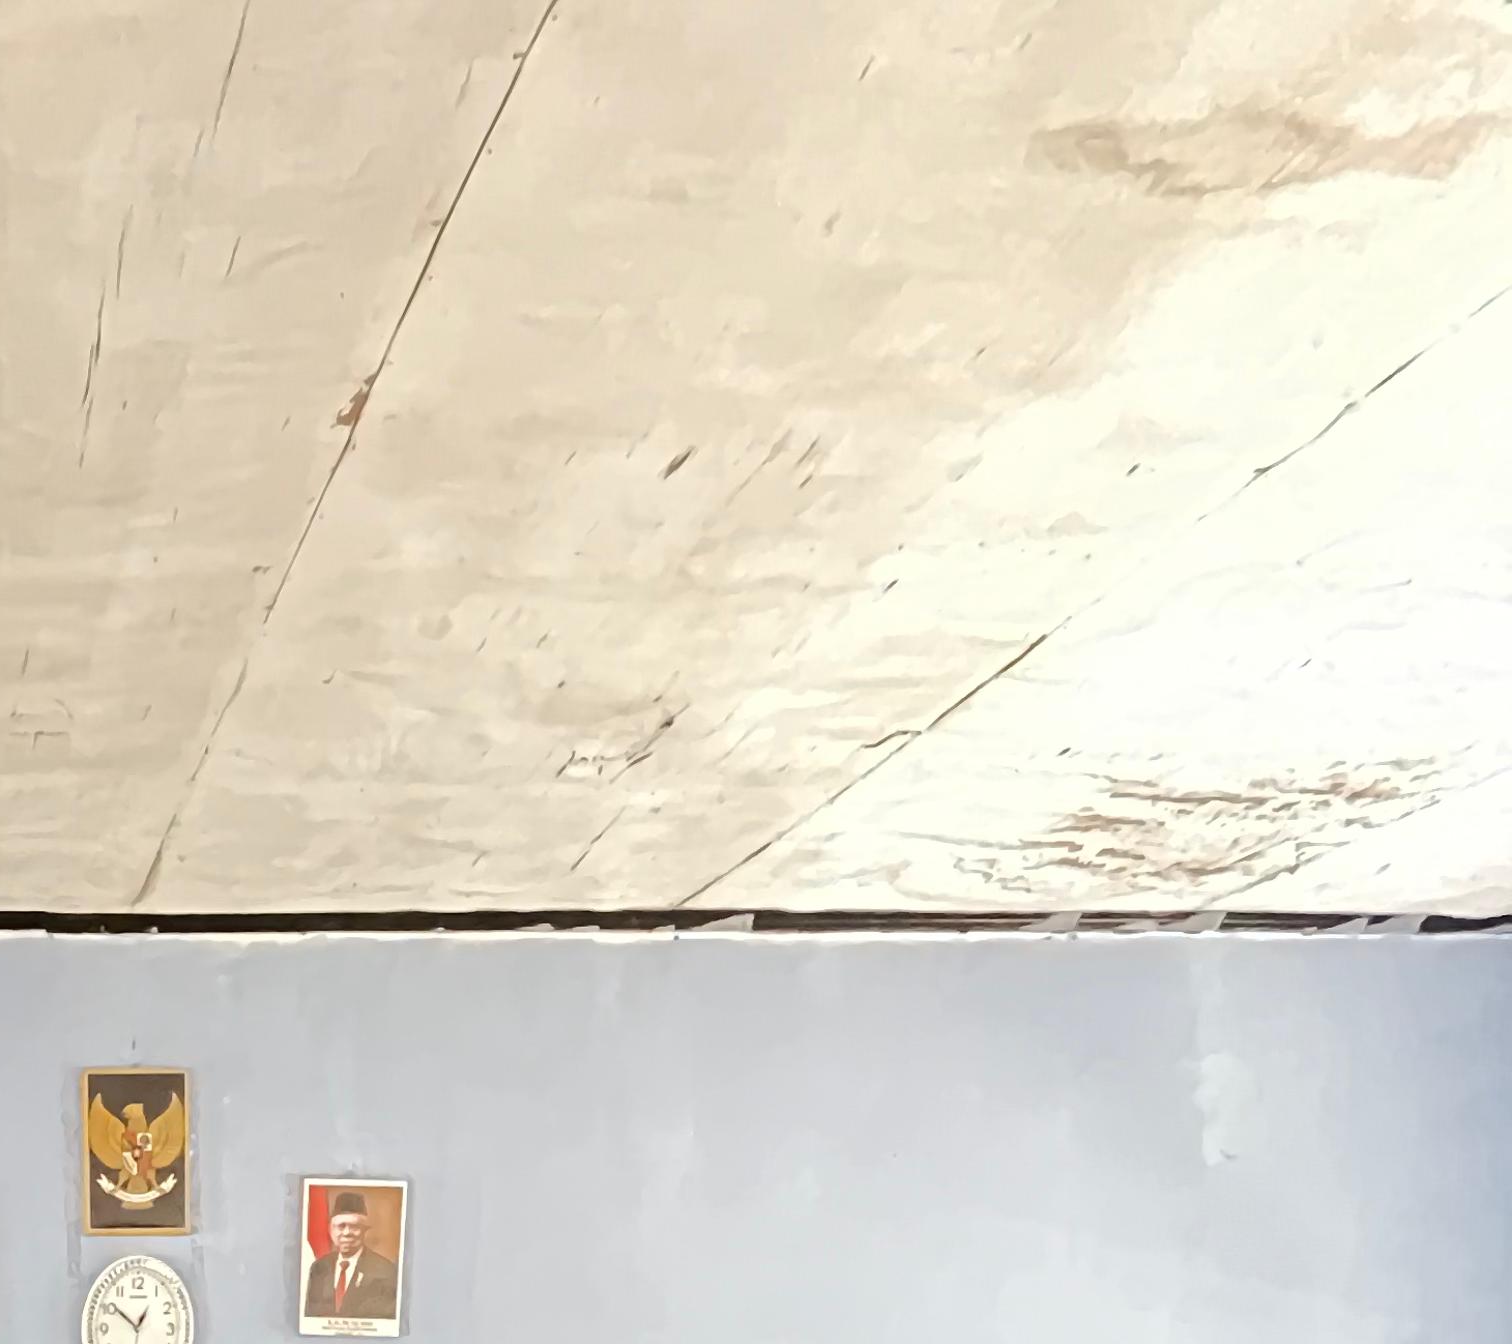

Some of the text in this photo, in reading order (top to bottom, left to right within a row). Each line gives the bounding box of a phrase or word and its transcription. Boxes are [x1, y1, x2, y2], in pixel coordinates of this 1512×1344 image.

[132, 1277, 145, 1290] 12
[116, 1286, 124, 1297] 11
[163, 1301, 172, 1315] 2
[99, 1322, 109, 1336] 9
[166, 1322, 175, 1336] 3
